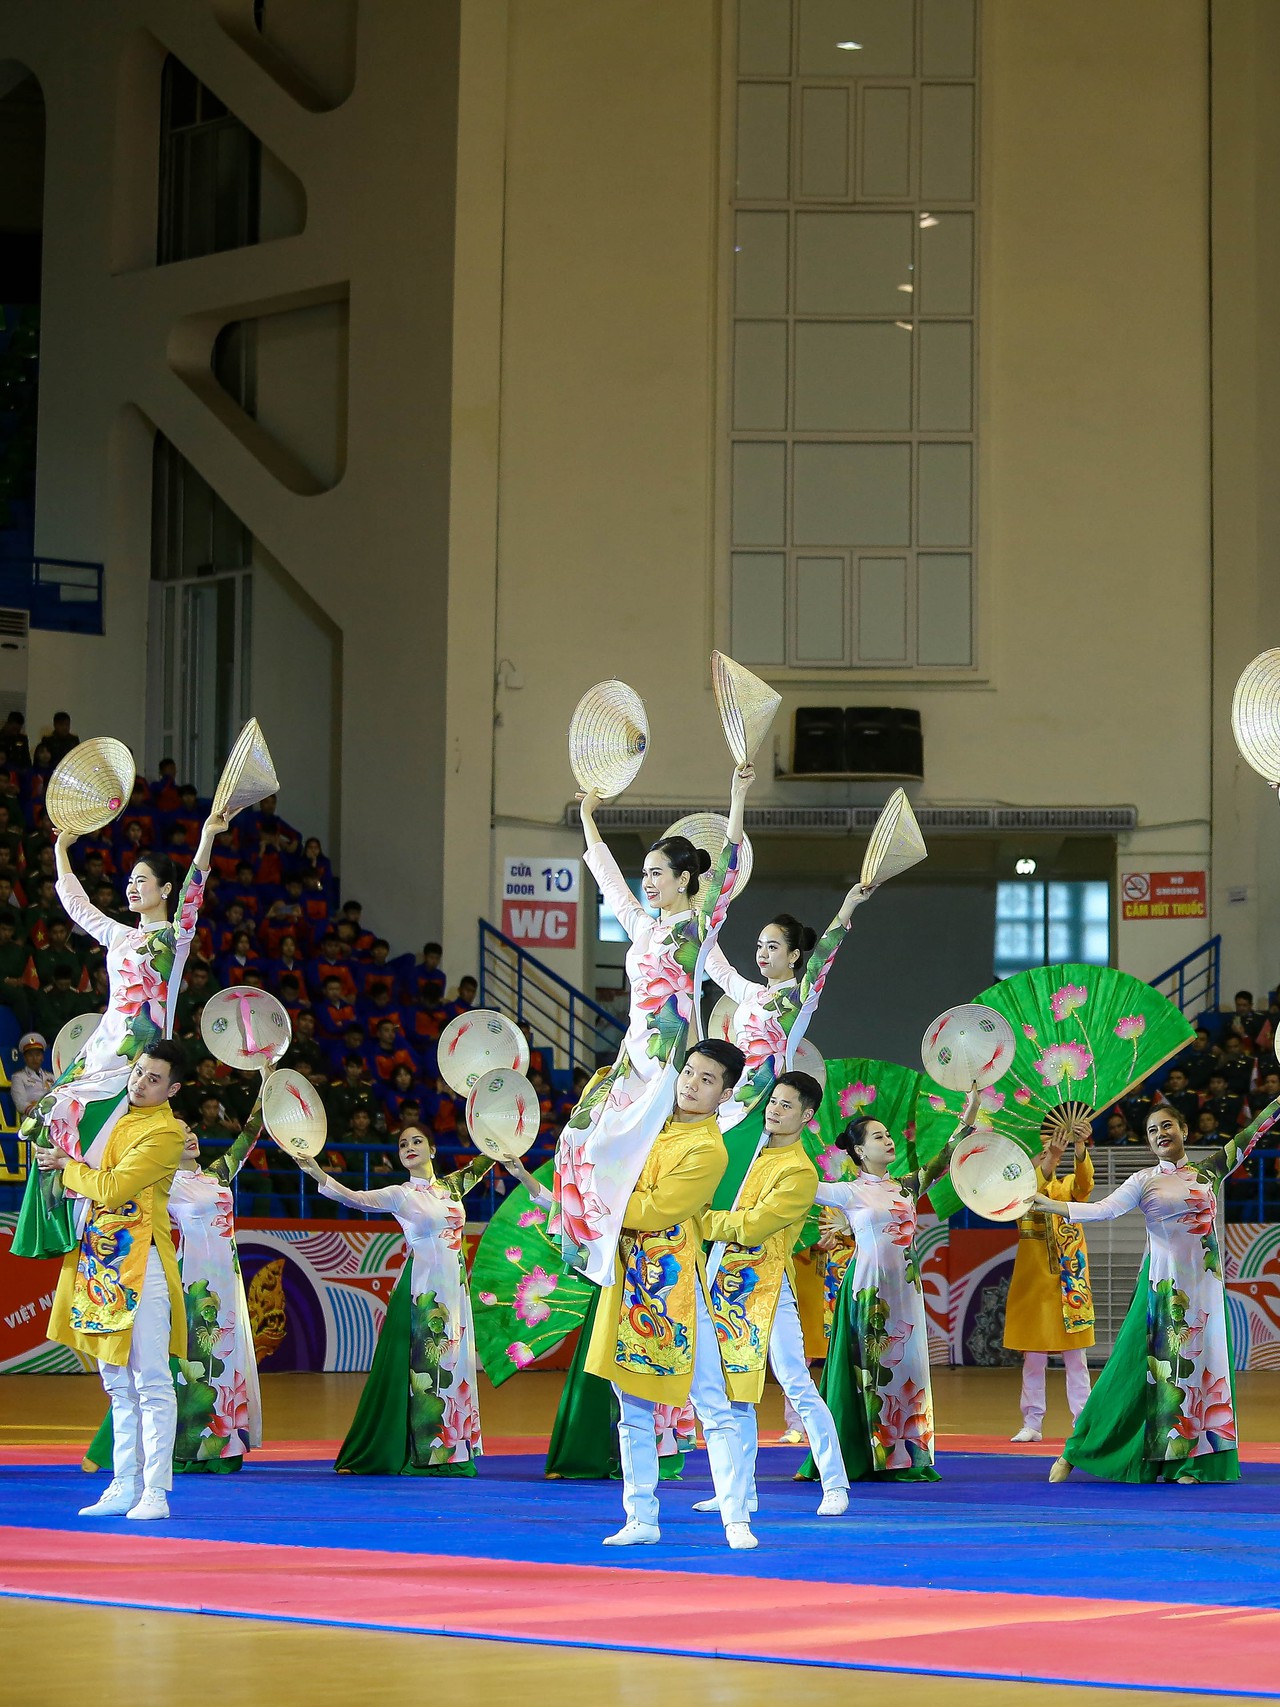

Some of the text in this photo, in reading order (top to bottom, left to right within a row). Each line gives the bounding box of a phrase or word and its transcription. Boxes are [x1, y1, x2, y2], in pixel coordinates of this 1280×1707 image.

[511, 863, 532, 877] CỬA
[541, 868, 573, 892] 10
[506, 884, 535, 895] DOOR
[1156, 887, 1199, 895] SMOKING
[1126, 900, 1204, 917] CẤM HÚT THUỐC
[510, 909, 569, 940] WC
[4, 1302, 37, 1329] VIỆT
